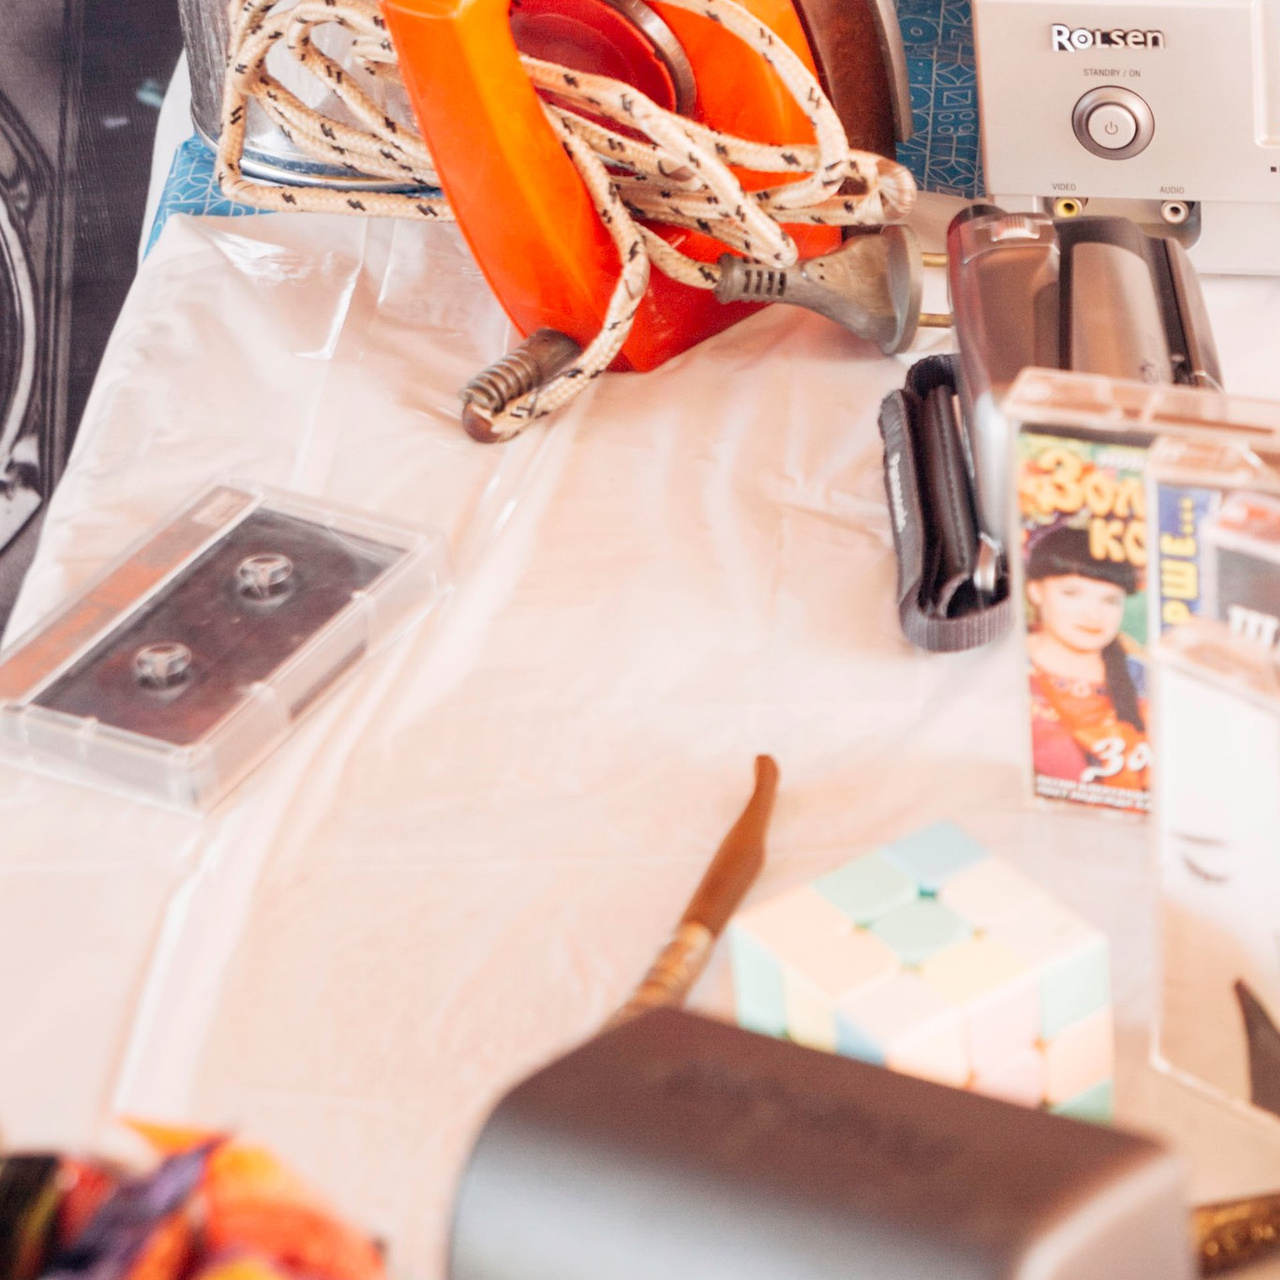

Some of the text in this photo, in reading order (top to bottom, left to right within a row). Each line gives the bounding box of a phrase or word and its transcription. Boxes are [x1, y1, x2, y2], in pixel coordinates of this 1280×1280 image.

[1083, 68, 1121, 78] STANDBY
[1129, 69, 1141, 78] ON
[1052, 182, 1185, 196] VIDEO AUDIO
